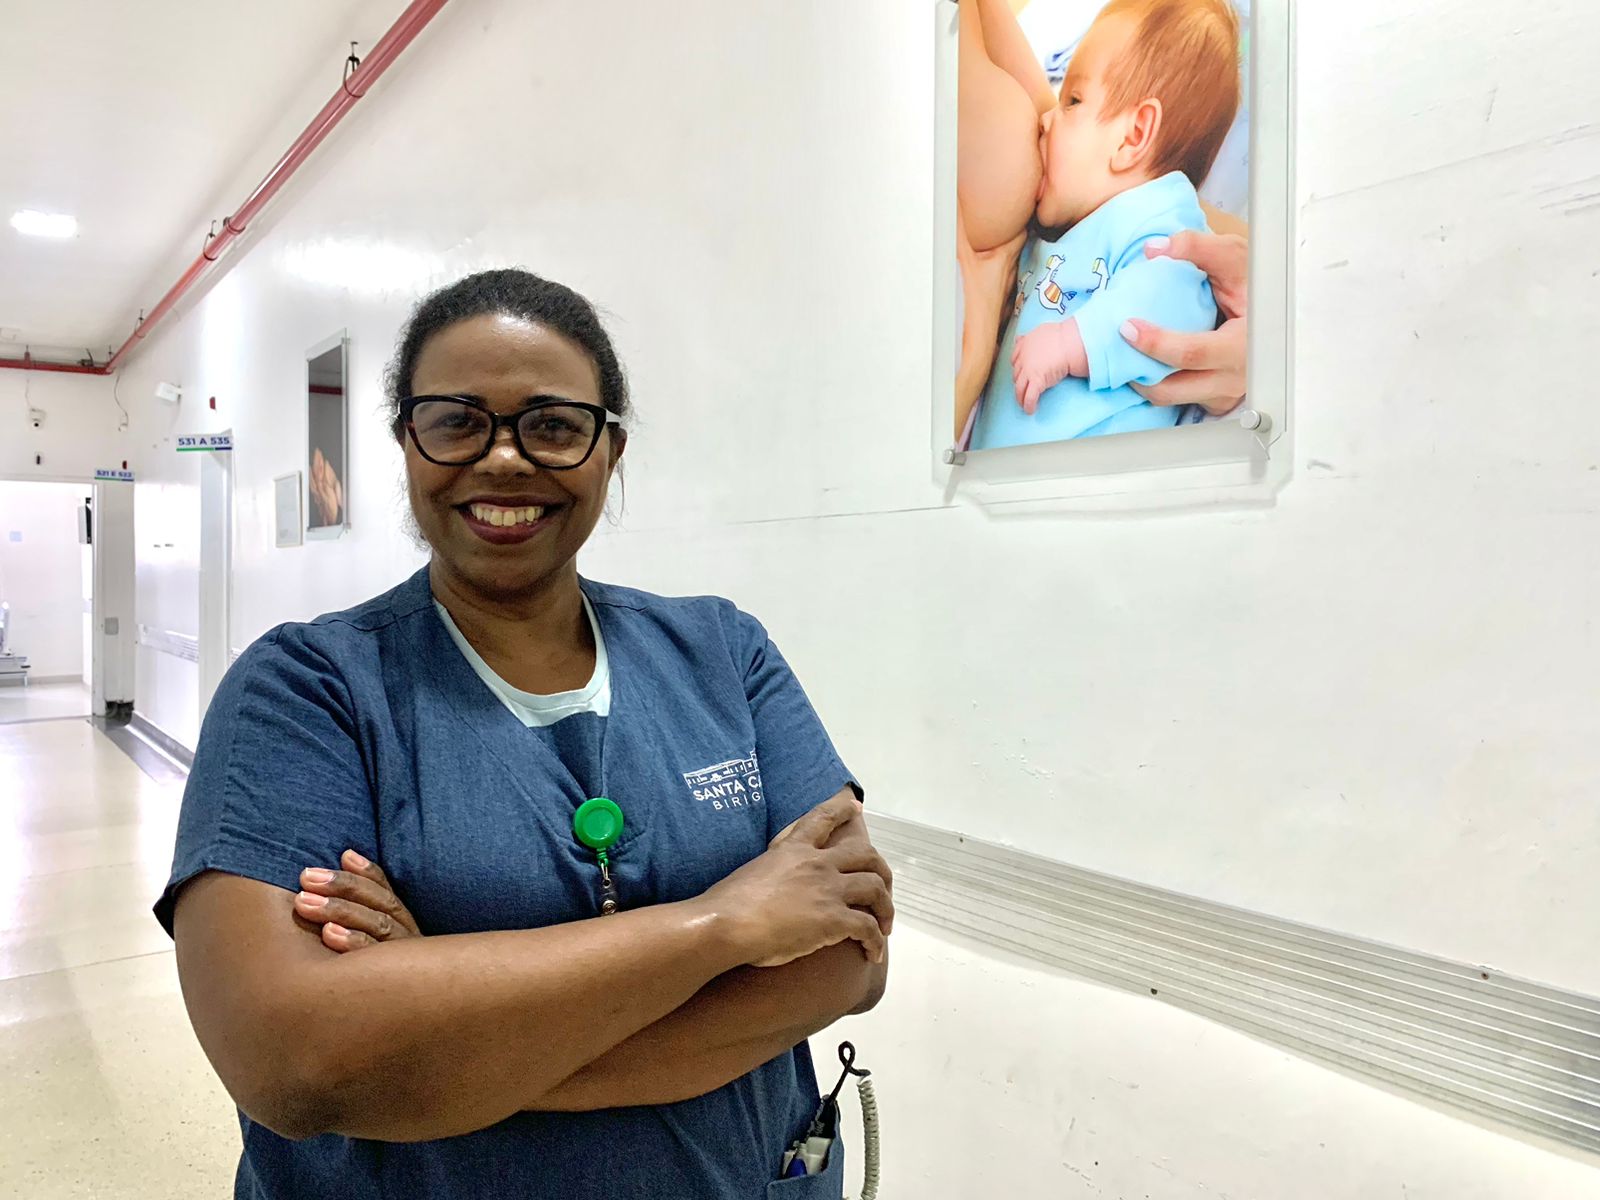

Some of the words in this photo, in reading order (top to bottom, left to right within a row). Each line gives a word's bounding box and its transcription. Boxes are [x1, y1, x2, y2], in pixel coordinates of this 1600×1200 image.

[178, 437, 196, 446] 531
[199, 437, 208, 446] A
[210, 436, 230, 445] 535
[693, 779, 746, 801] SANTA
